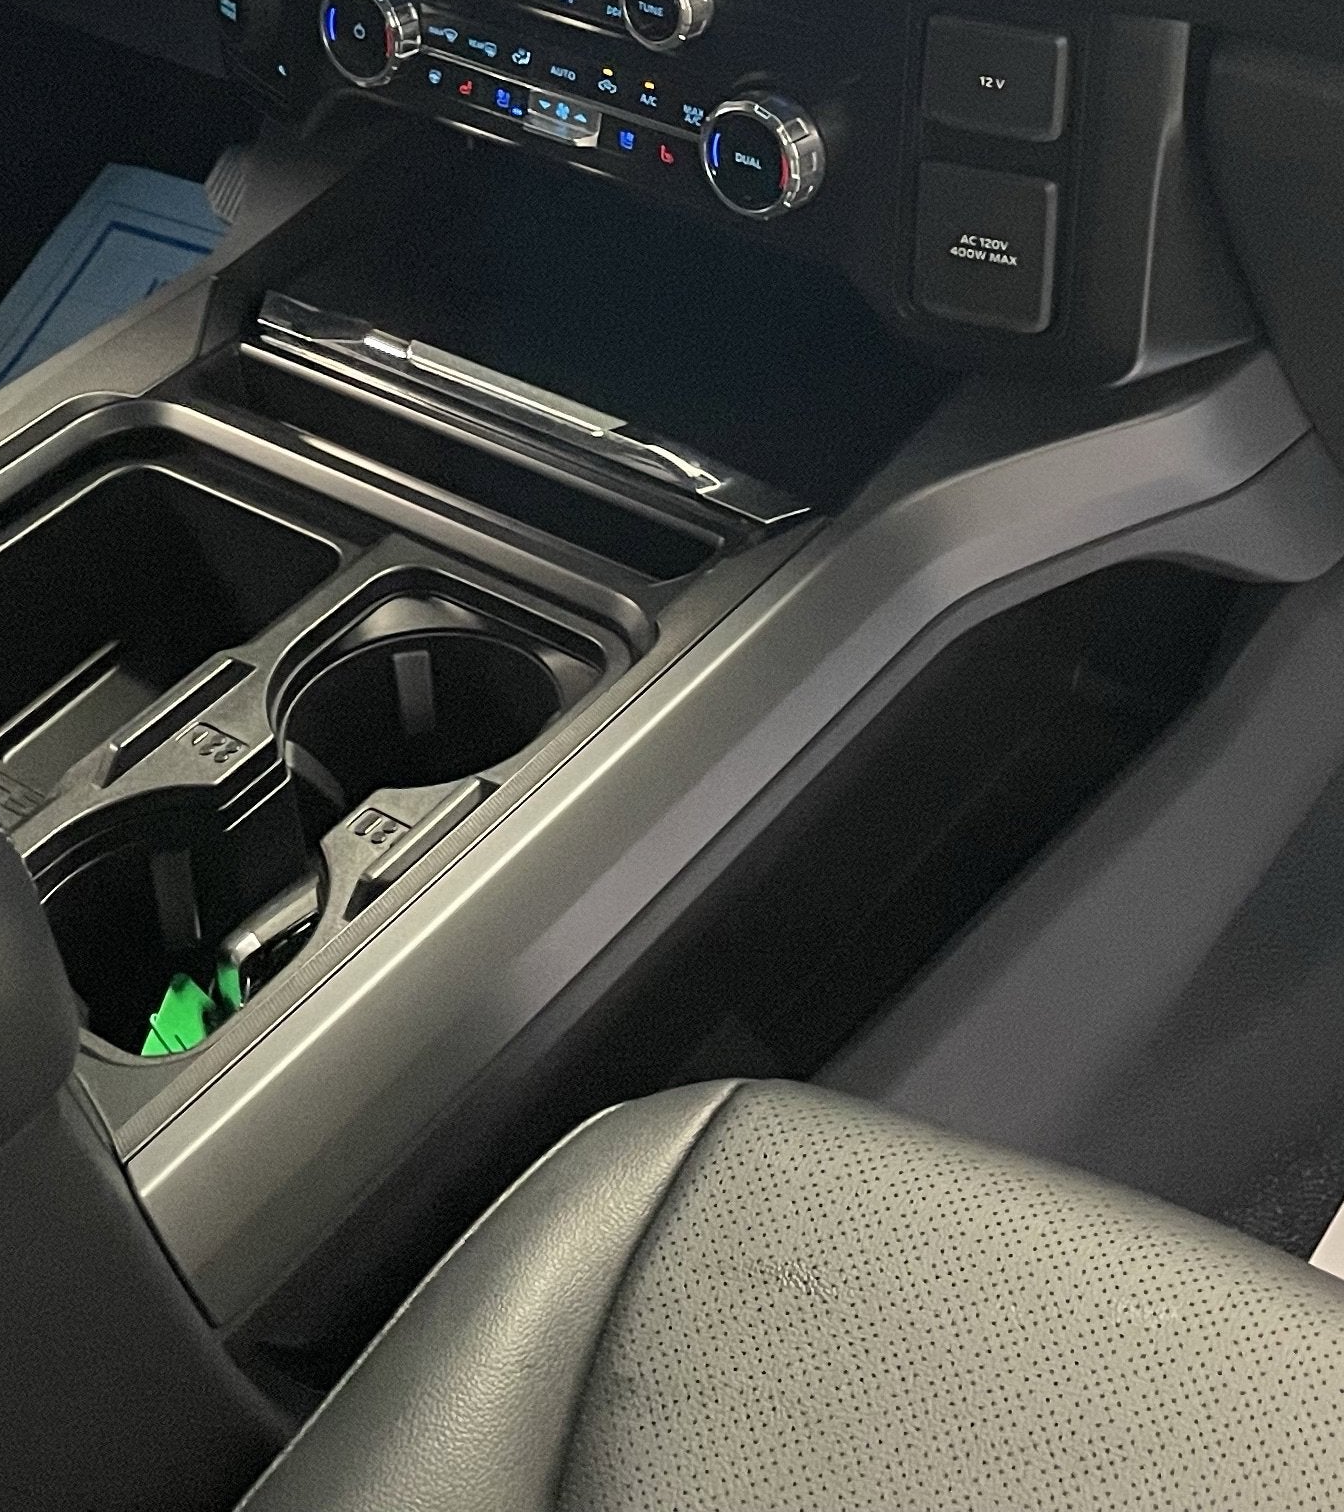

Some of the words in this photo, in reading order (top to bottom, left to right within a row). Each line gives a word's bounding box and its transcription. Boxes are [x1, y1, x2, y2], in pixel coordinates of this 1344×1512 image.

[638, 0, 664, 18] TUNE
[550, 65, 576, 82] AUTO
[979, 75, 994, 88] 12
[996, 78, 1006, 89] V
[639, 93, 657, 107] A/C
[683, 104, 703, 118] MAX
[735, 152, 762, 170] DUAL
[960, 234, 977, 247] AC
[979, 237, 1009, 251] 120V
[950, 246, 986, 261] 400W
[989, 252, 1017, 266] MAX
